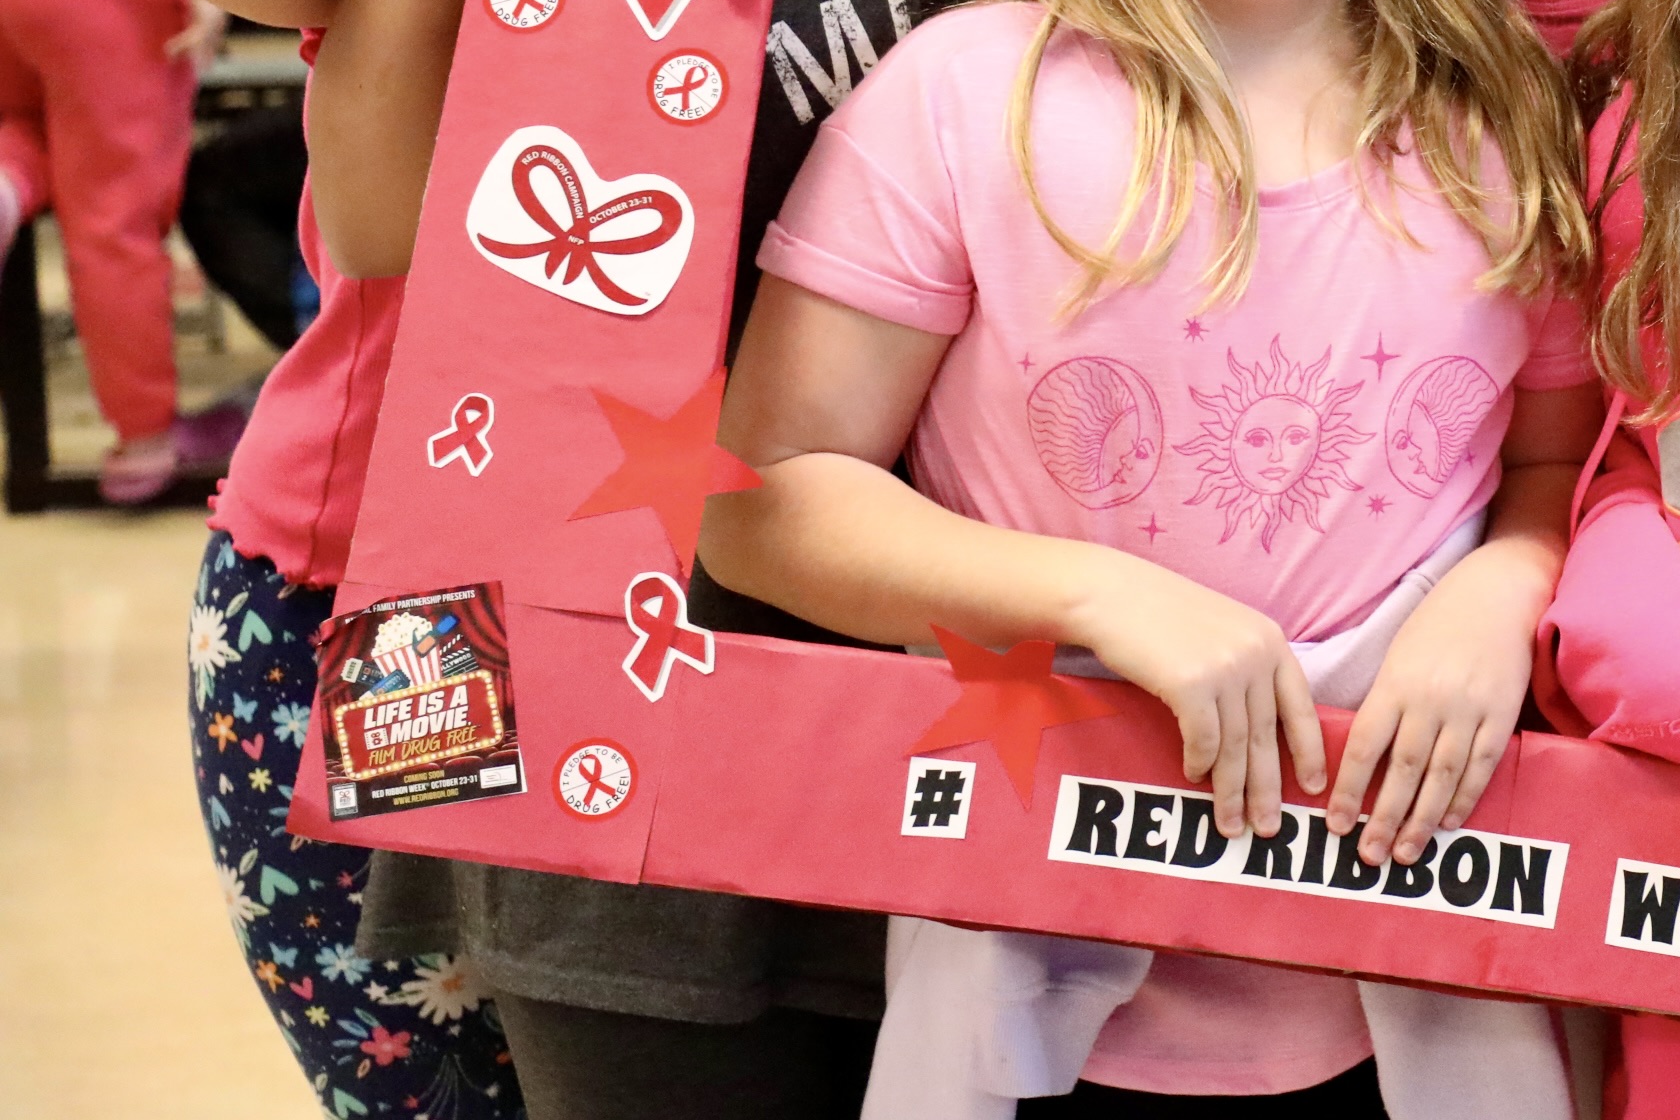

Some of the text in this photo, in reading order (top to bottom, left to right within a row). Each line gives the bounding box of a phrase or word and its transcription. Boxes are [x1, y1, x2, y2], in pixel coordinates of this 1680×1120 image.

[496, 7, 528, 26] DRUG
[710, 72, 718, 84] TO
[655, 75, 706, 118] DRUG FREE!
[521, 150, 585, 219] RED RIBBON CAMPAIGN
[588, 195, 653, 224] OCTOBER 23-31
[568, 234, 585, 245] NFP
[373, 590, 476, 613] FAMILY PARTNERSHIP PRESENTS
[363, 685, 468, 729] LIFE IS A
[390, 706, 472, 745] MOVIE.
[369, 725, 478, 766] FILM DRUG FREE
[563, 749, 590, 778] PLEDGE
[611, 753, 622, 764] BE
[372, 790, 384, 799] RED
[385, 787, 408, 797] RIBBON
[430, 779, 458, 790] OCTOBER
[459, 775, 478, 785] 23-31
[566, 776, 629, 813] DRUG FREE!
[909, 768, 966, 828] #
[1065, 782, 1229, 869] RED
